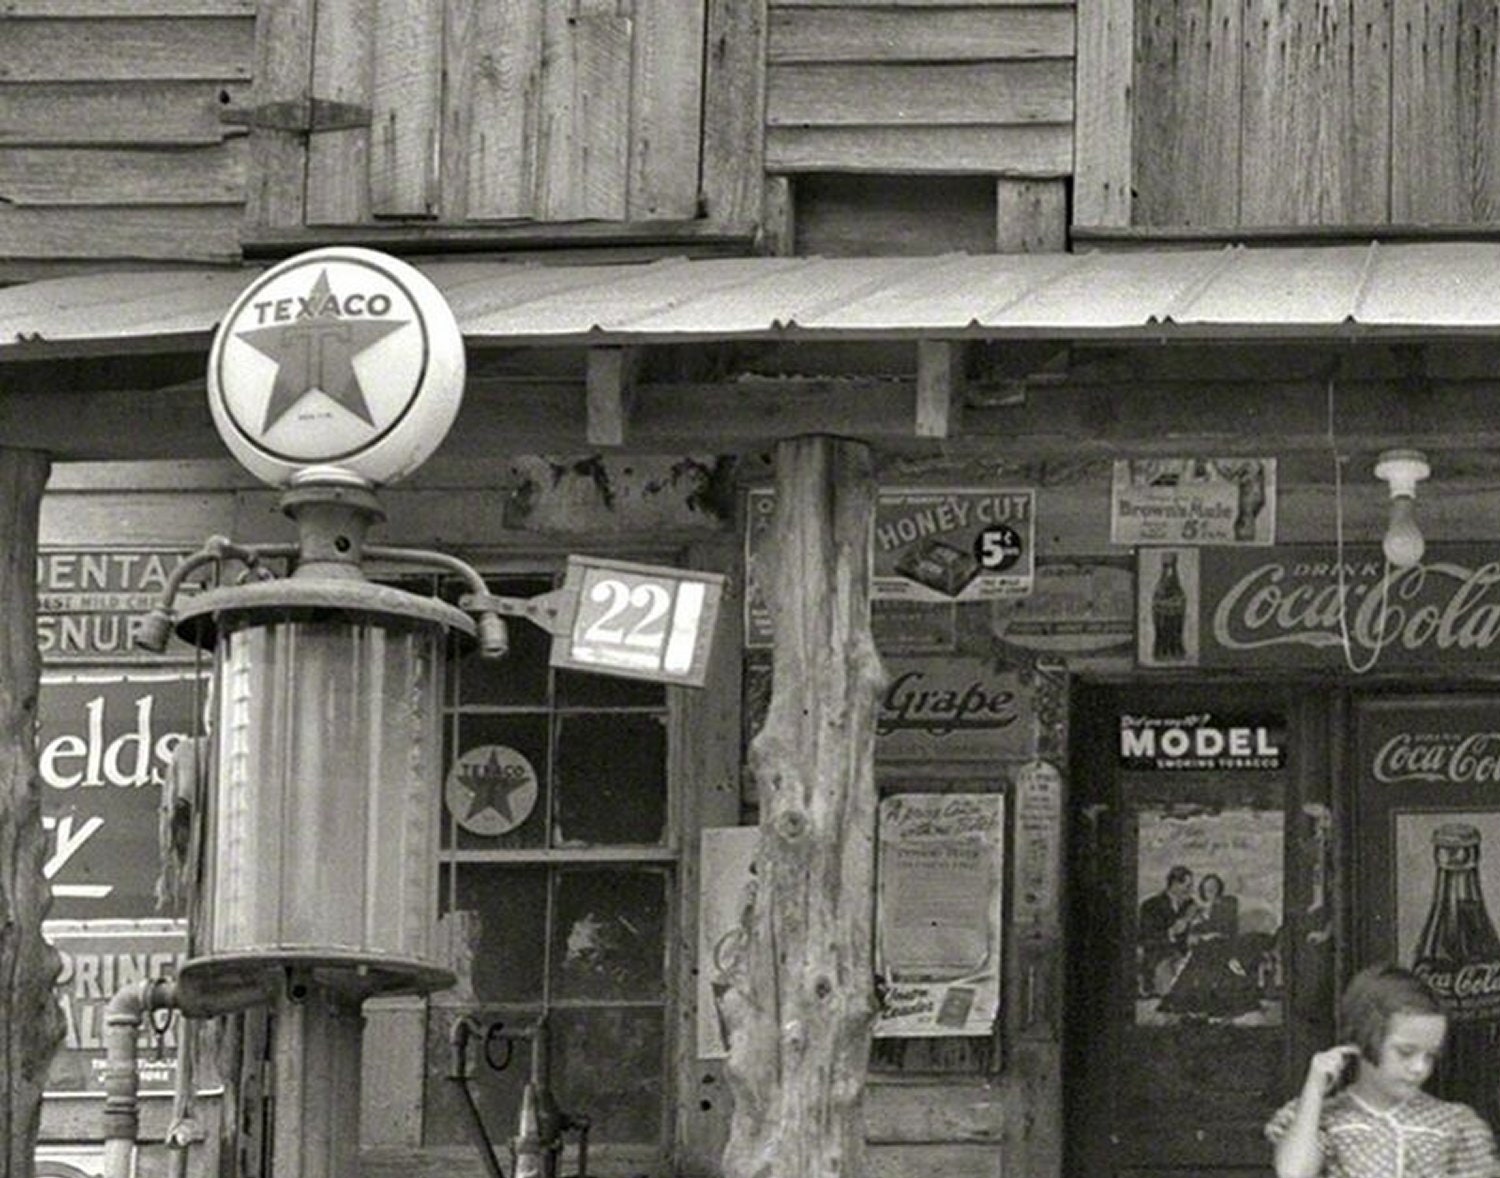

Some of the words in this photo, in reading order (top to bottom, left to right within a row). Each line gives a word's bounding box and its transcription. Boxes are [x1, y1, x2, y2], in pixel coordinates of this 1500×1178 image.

[254, 293, 391, 324] TEXACO
[877, 501, 970, 550] HONEY
[976, 496, 1029, 523] CUT
[1293, 562, 1379, 577] DRINK
[884, 671, 1014, 724] Grape
[1121, 728, 1279, 756] MODEL
[1219, 759, 1279, 769] TOBACCO
